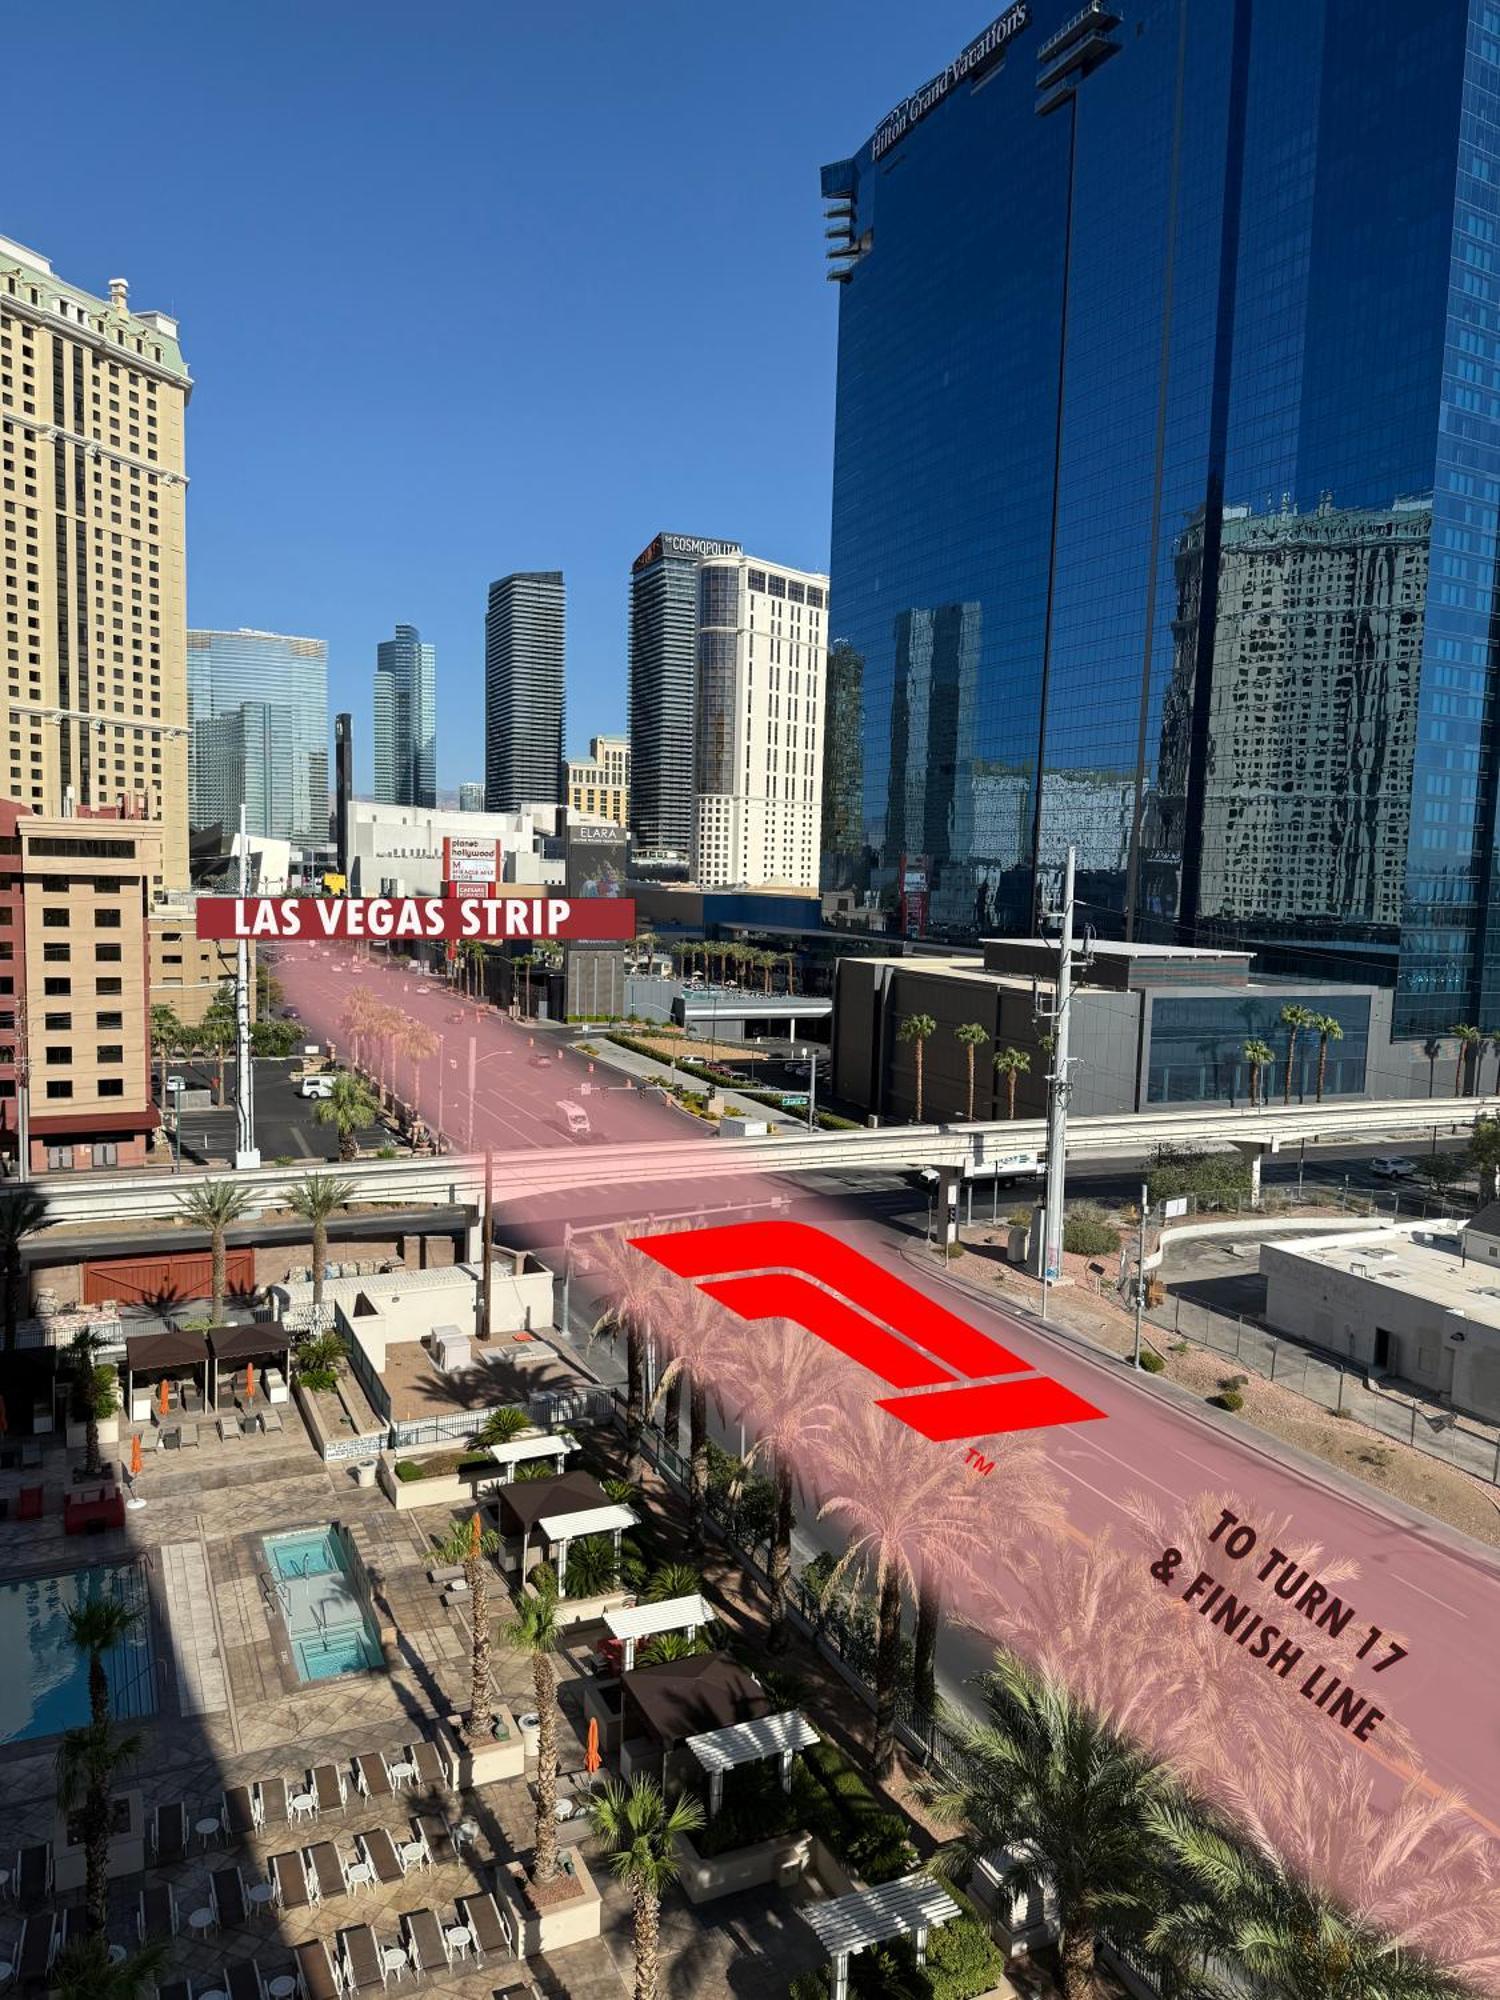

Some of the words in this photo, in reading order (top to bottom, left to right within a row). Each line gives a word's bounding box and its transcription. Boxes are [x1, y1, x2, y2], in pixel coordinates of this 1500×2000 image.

[871, 114, 907, 161] Hilton
[910, 68, 949, 121] Grand
[950, 4, 1027, 82] Vacations
[580, 827, 617, 839] ELARA
[452, 839, 479, 848] planet
[451, 848, 494, 858] hollywood
